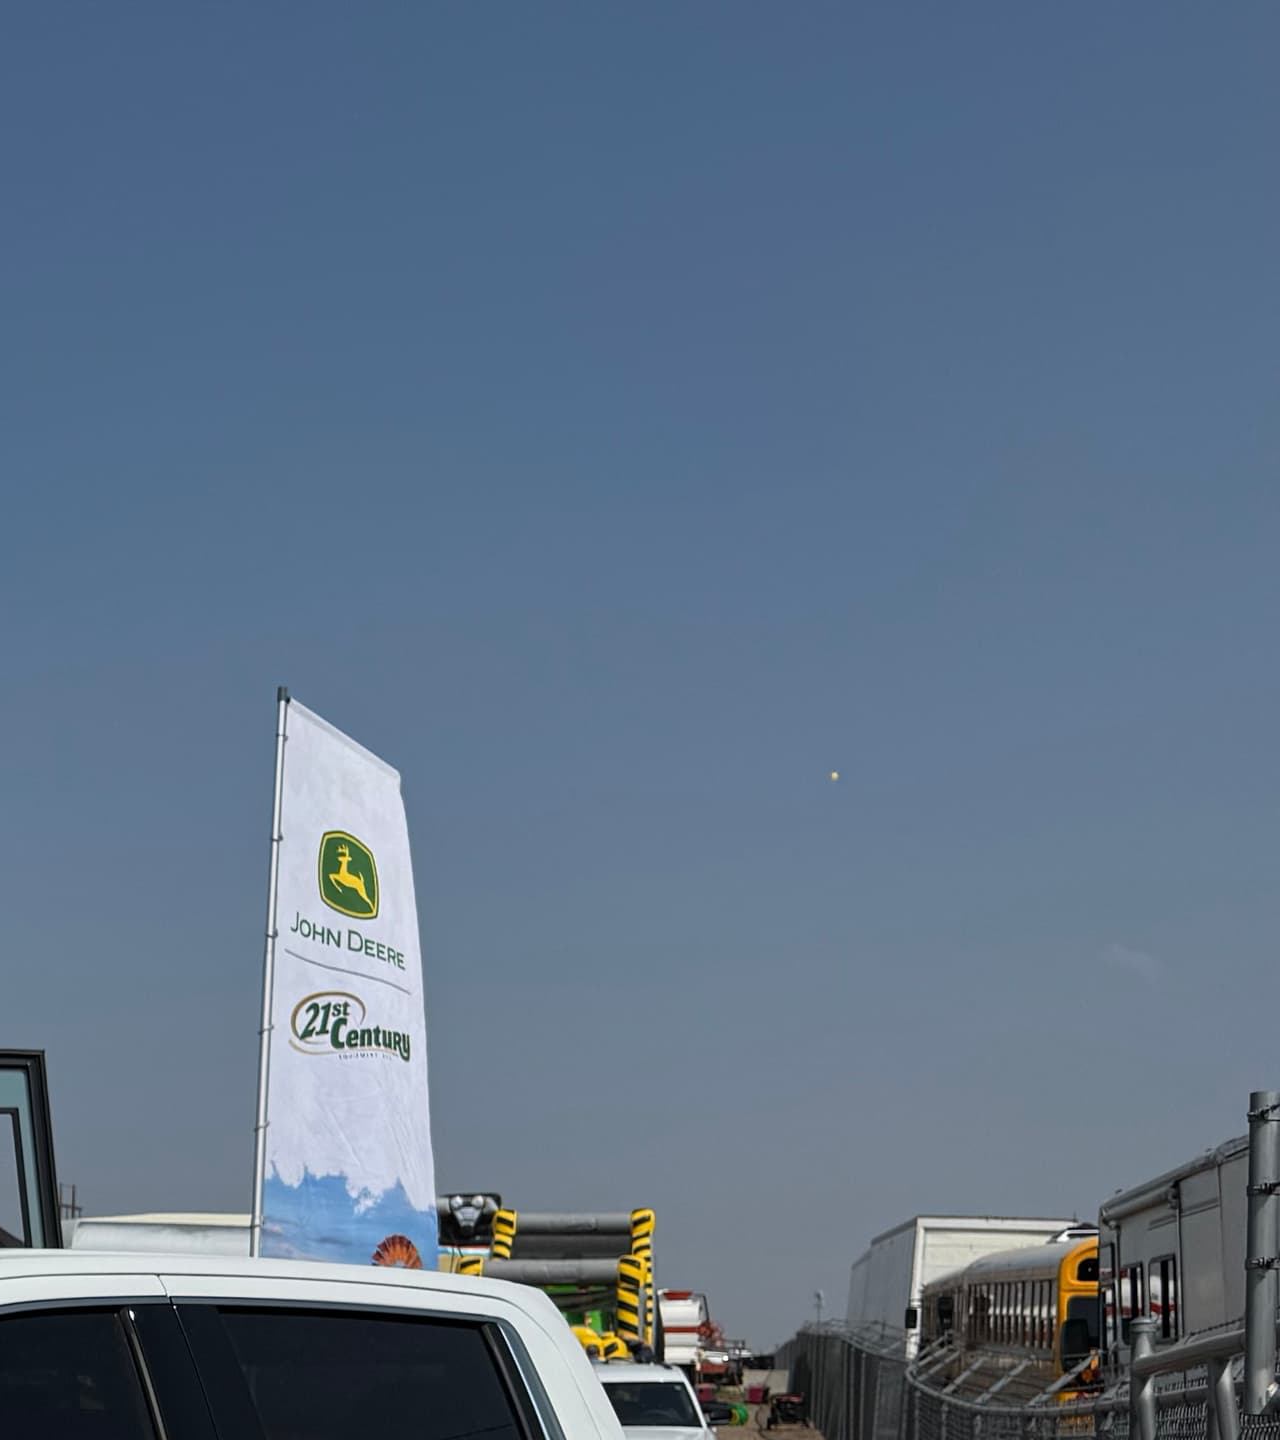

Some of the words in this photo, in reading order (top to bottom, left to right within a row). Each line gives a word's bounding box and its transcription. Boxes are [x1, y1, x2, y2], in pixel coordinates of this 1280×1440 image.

[290, 911, 342, 949] JOHN
[347, 929, 406, 971] DEERE
[299, 1001, 351, 1041] 21st
[330, 1017, 411, 1063] Century
